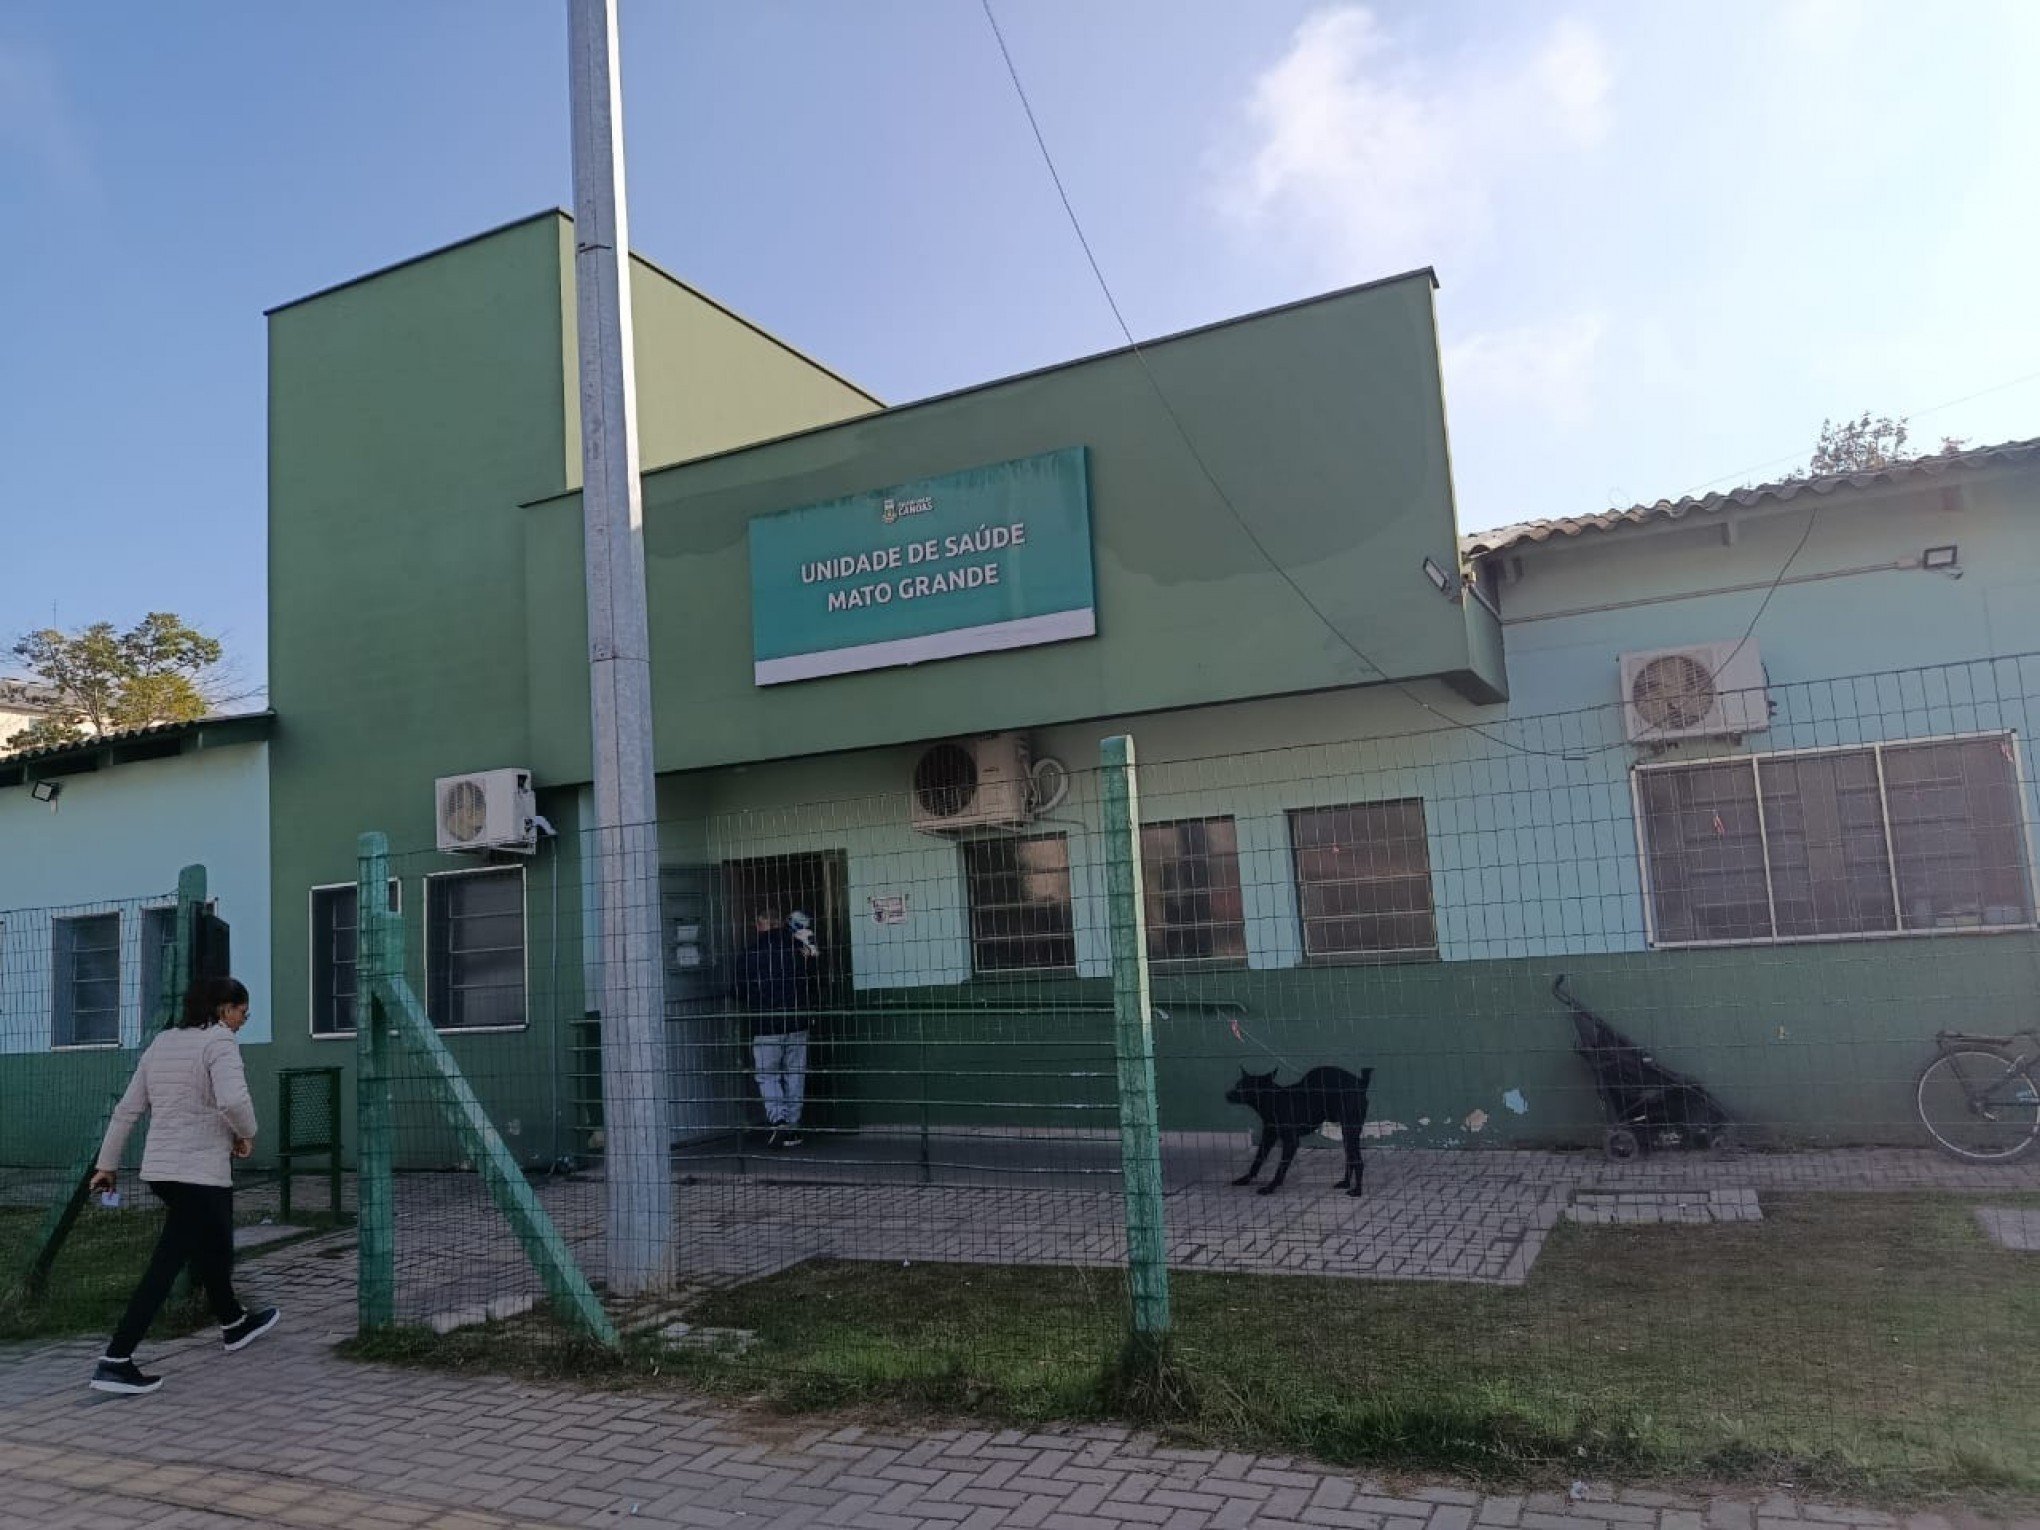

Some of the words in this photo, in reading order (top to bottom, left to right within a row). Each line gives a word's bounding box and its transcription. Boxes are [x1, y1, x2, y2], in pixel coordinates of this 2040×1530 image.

[801, 548, 901, 583] UNIDADE
[908, 540, 938, 563] DE
[945, 523, 1025, 557] SAÚDE
[827, 583, 892, 612] MATO
[899, 563, 999, 599] GRANDE
